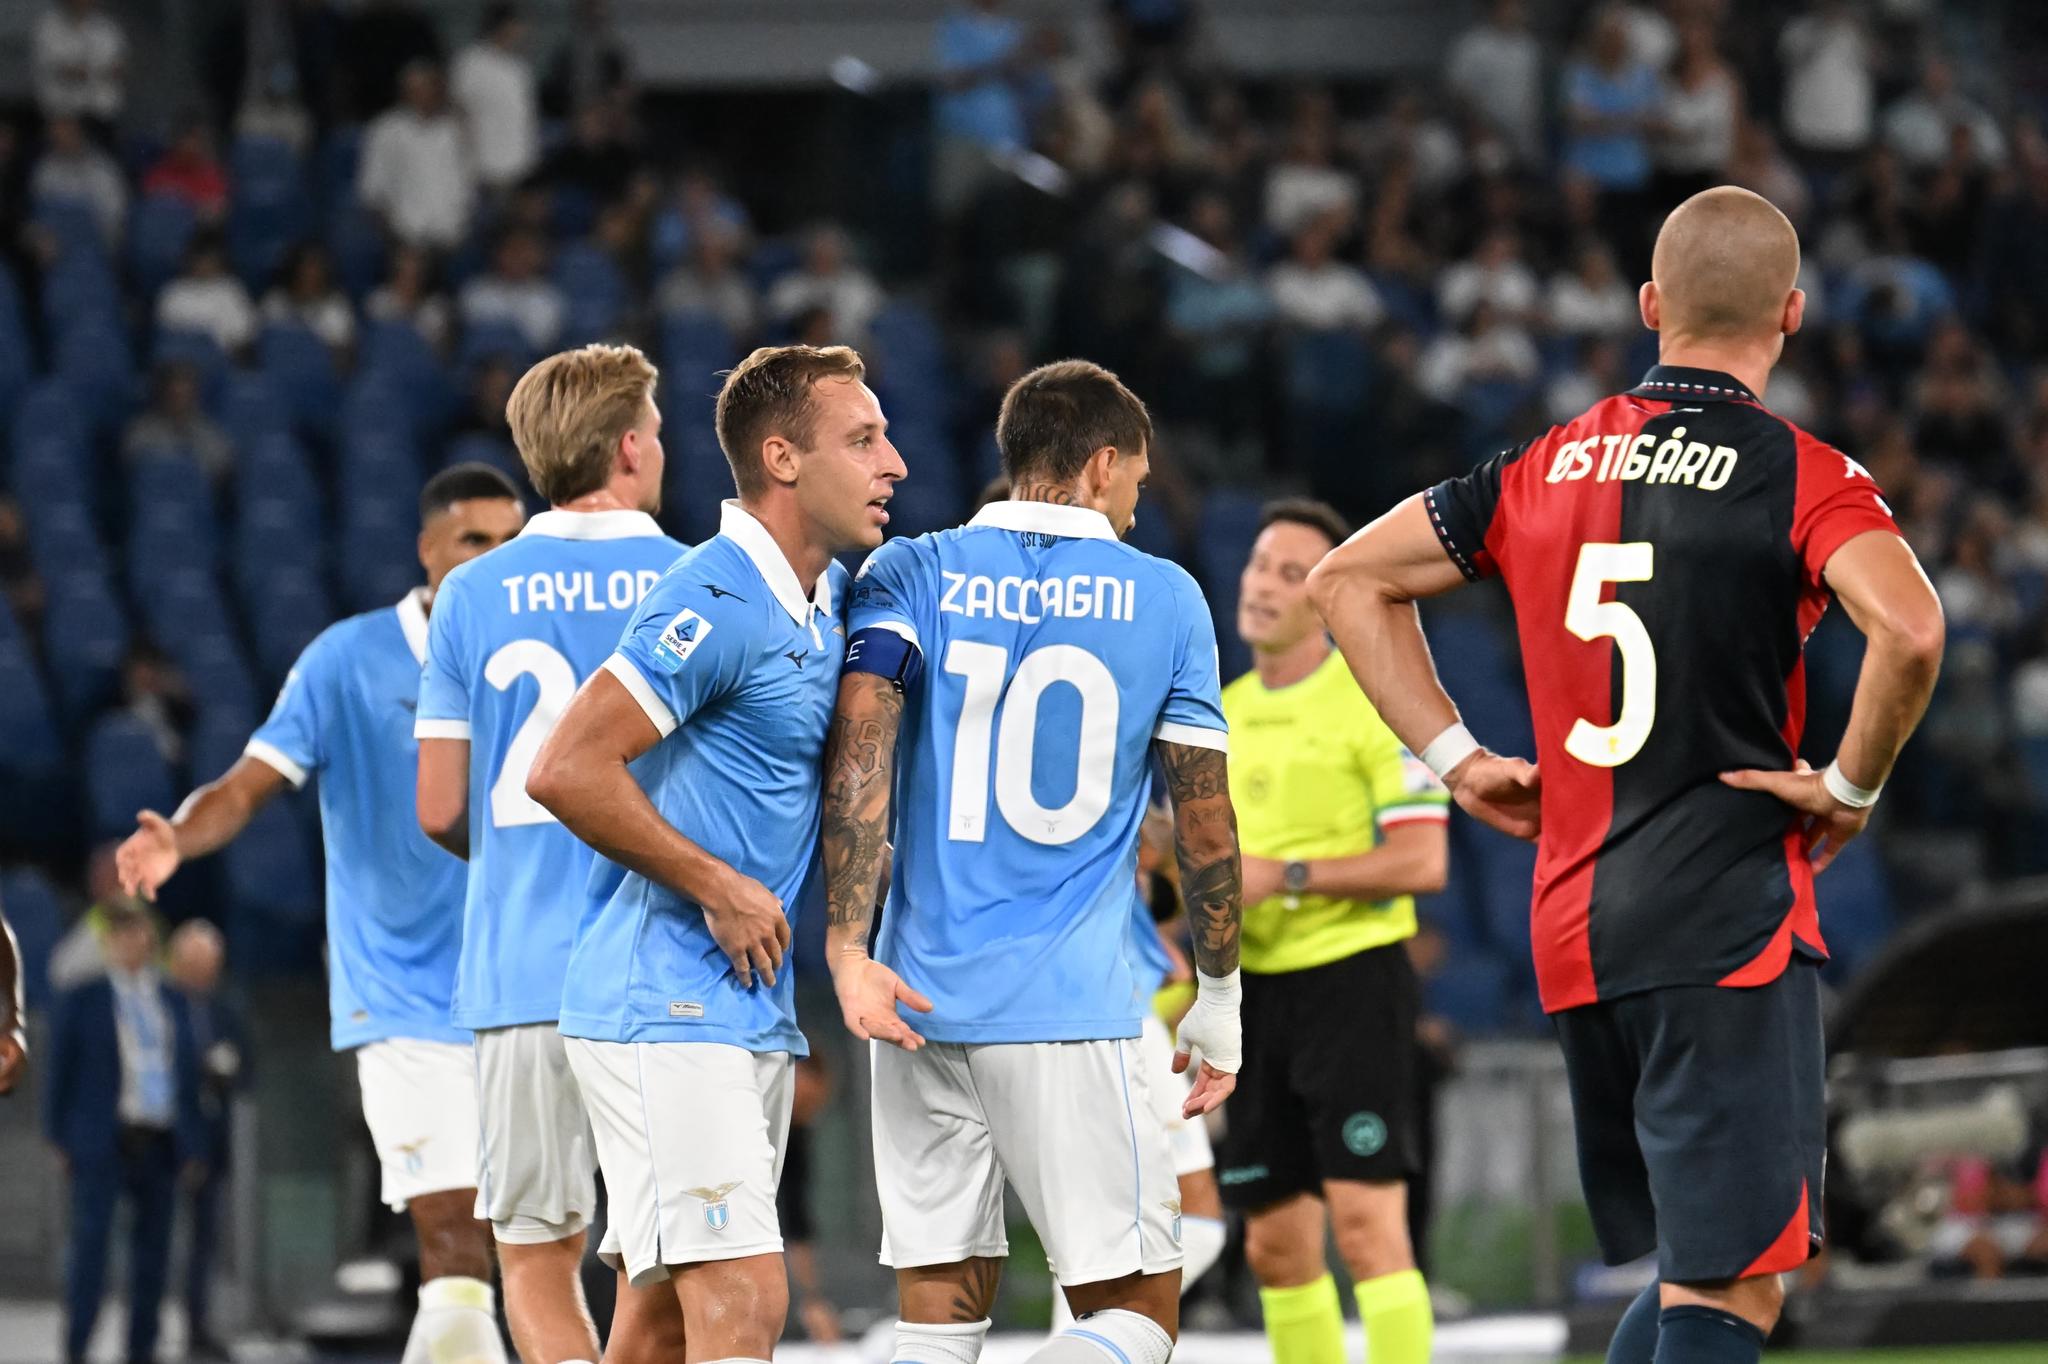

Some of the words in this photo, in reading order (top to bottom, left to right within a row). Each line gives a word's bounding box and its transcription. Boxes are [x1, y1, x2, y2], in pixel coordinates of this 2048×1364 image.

[1545, 426, 1738, 491] ØSTIGÅRD
[940, 570, 1135, 625] ZACCAGNI
[665, 634, 683, 649] SERIE
[1564, 541, 1657, 768] 5
[944, 639, 1120, 846] 10
